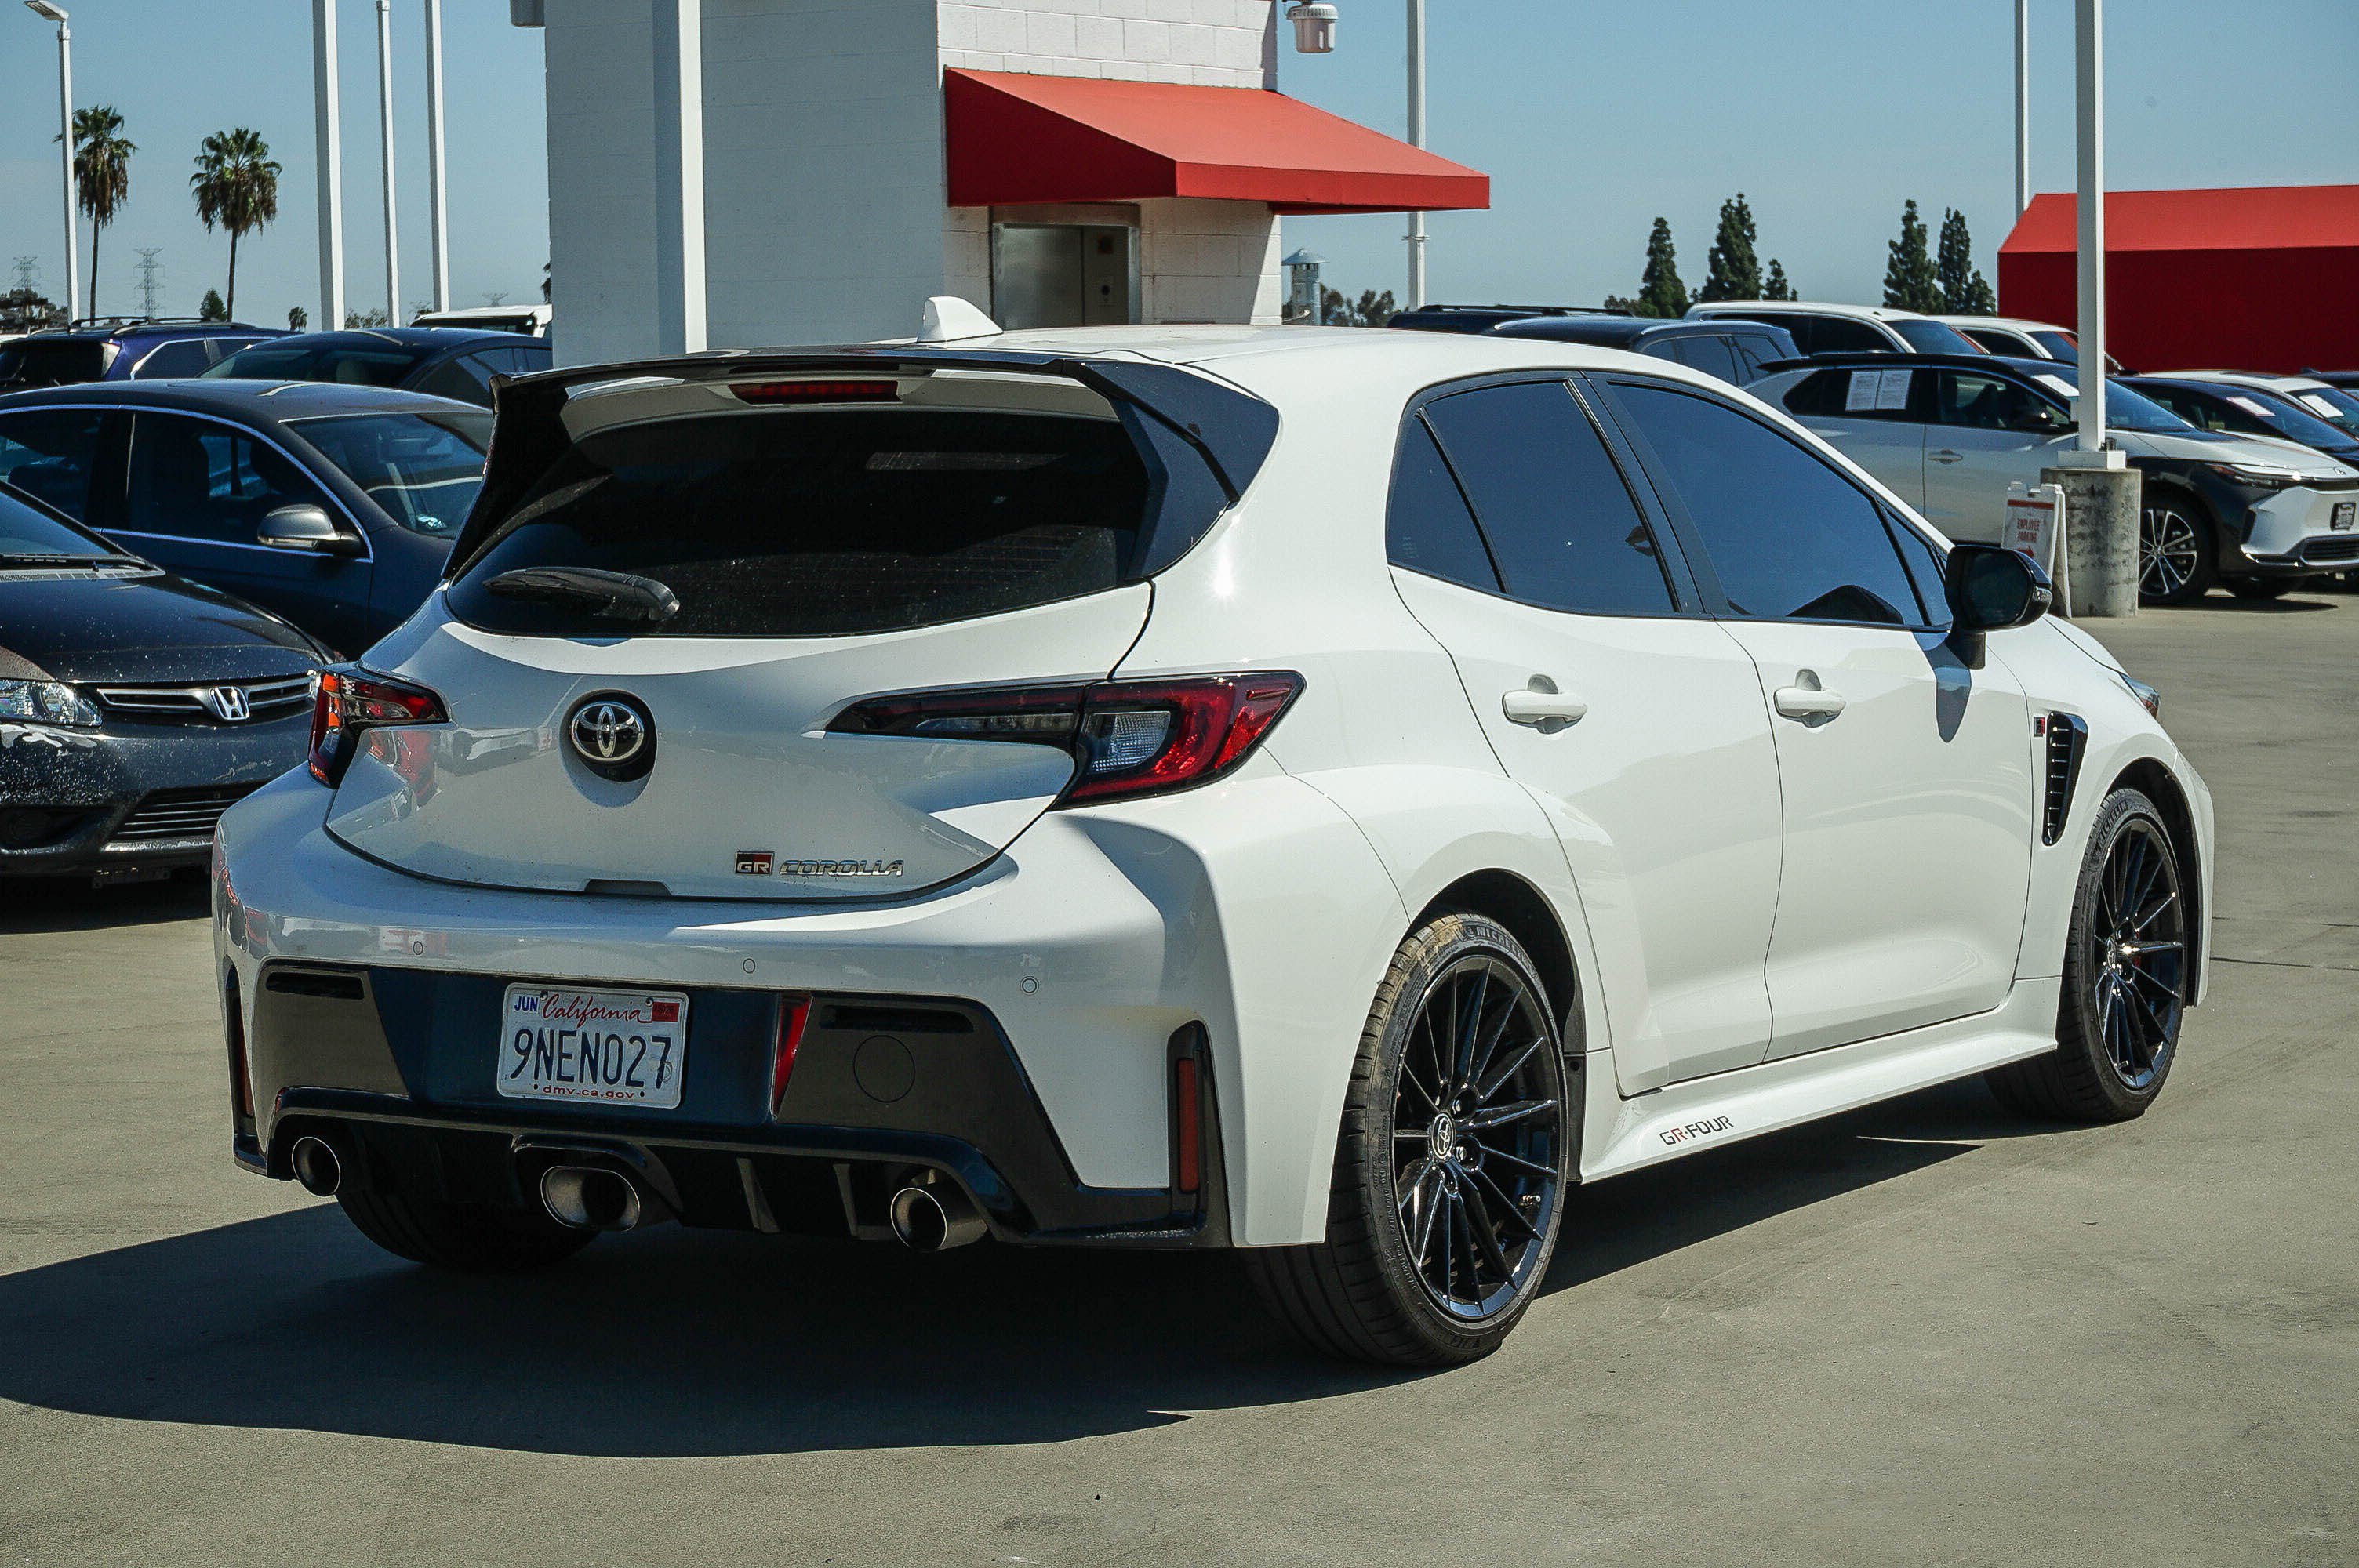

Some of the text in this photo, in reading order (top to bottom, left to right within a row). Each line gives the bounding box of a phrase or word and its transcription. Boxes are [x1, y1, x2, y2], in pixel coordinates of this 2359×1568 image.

[2095, 799, 2129, 851] MICHELIN
[736, 859, 904, 877] GR COROLLA
[514, 996, 539, 1012] JUN
[542, 993, 652, 1029] California
[510, 1028, 671, 1089] 9NEN027
[543, 1084, 635, 1099] dmv.ca.gov
